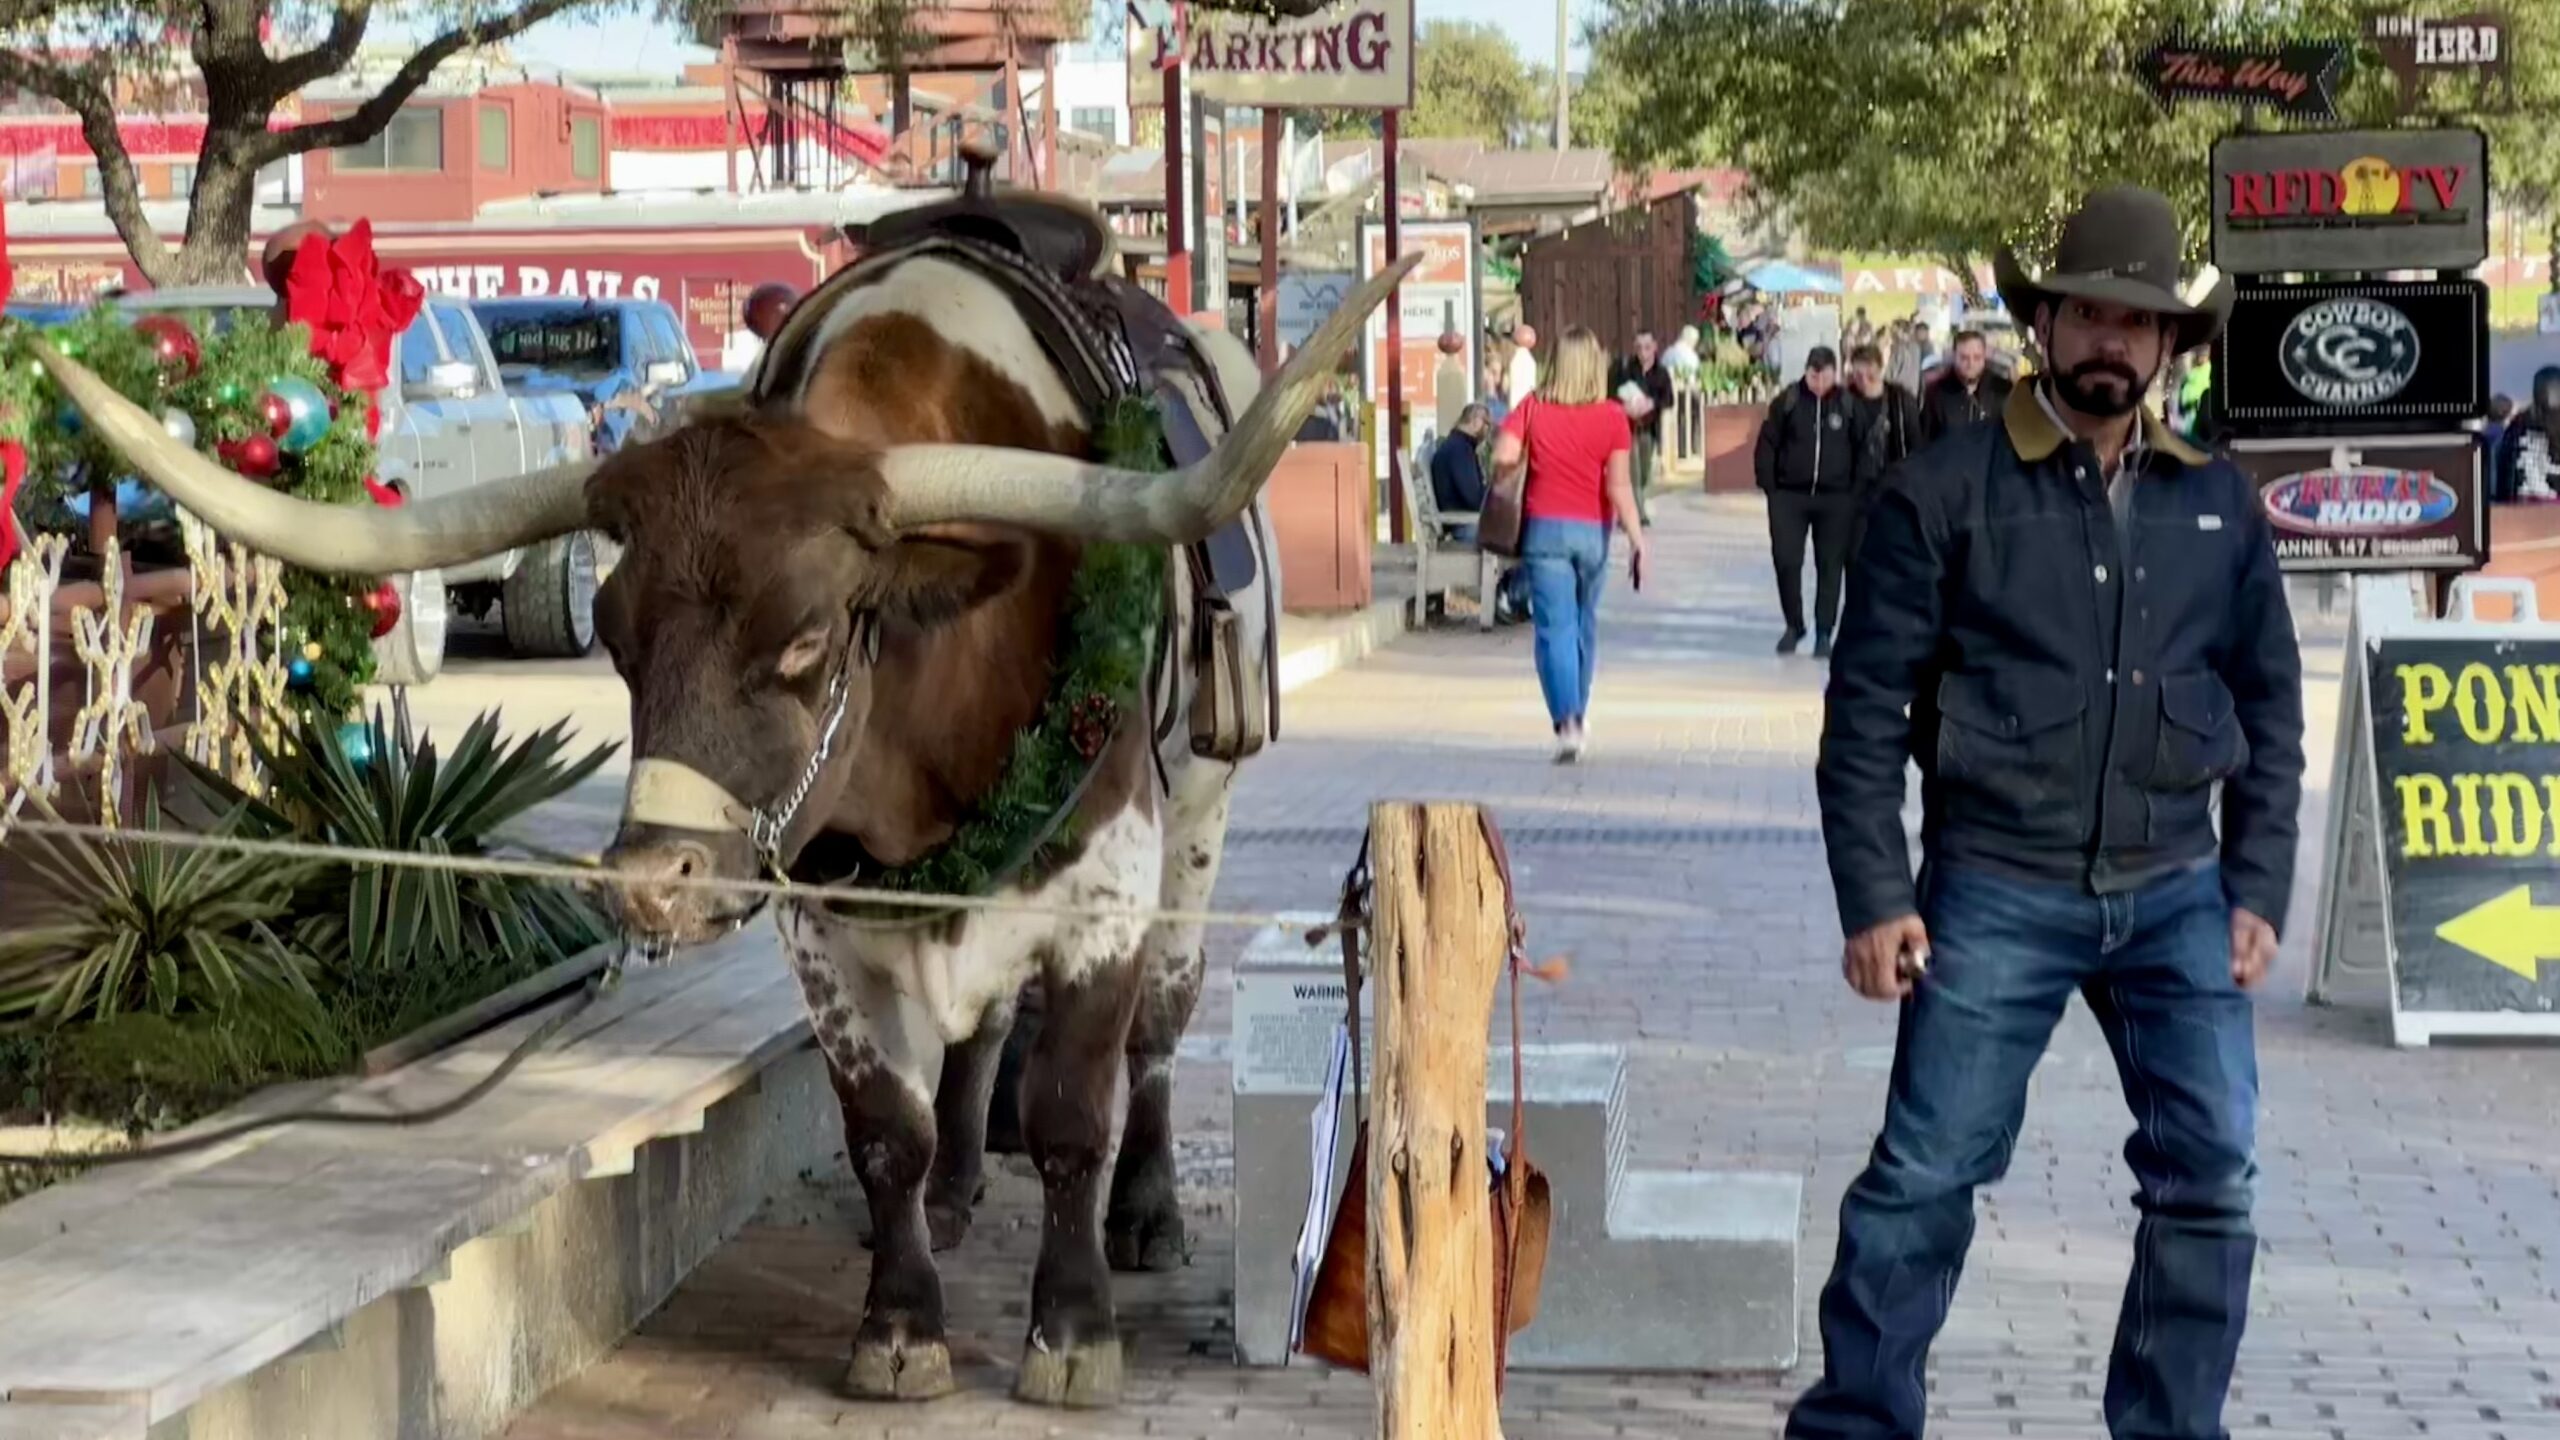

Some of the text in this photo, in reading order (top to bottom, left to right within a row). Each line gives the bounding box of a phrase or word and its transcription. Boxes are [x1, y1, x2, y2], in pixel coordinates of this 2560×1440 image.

[2415, 25, 2498, 64] HERD
[2160, 52, 2308, 102] This Way
[411, 265, 660, 302] THE RAILS
[2299, 302, 2407, 338] COWBOY
[2300, 368, 2403, 403] CHANNEL
[2315, 500, 2422, 526] RADIO
[2272, 538, 2333, 557] ANNEL
[2395, 661, 2560, 744] PON
[1293, 984, 1348, 1000] WARNIN
